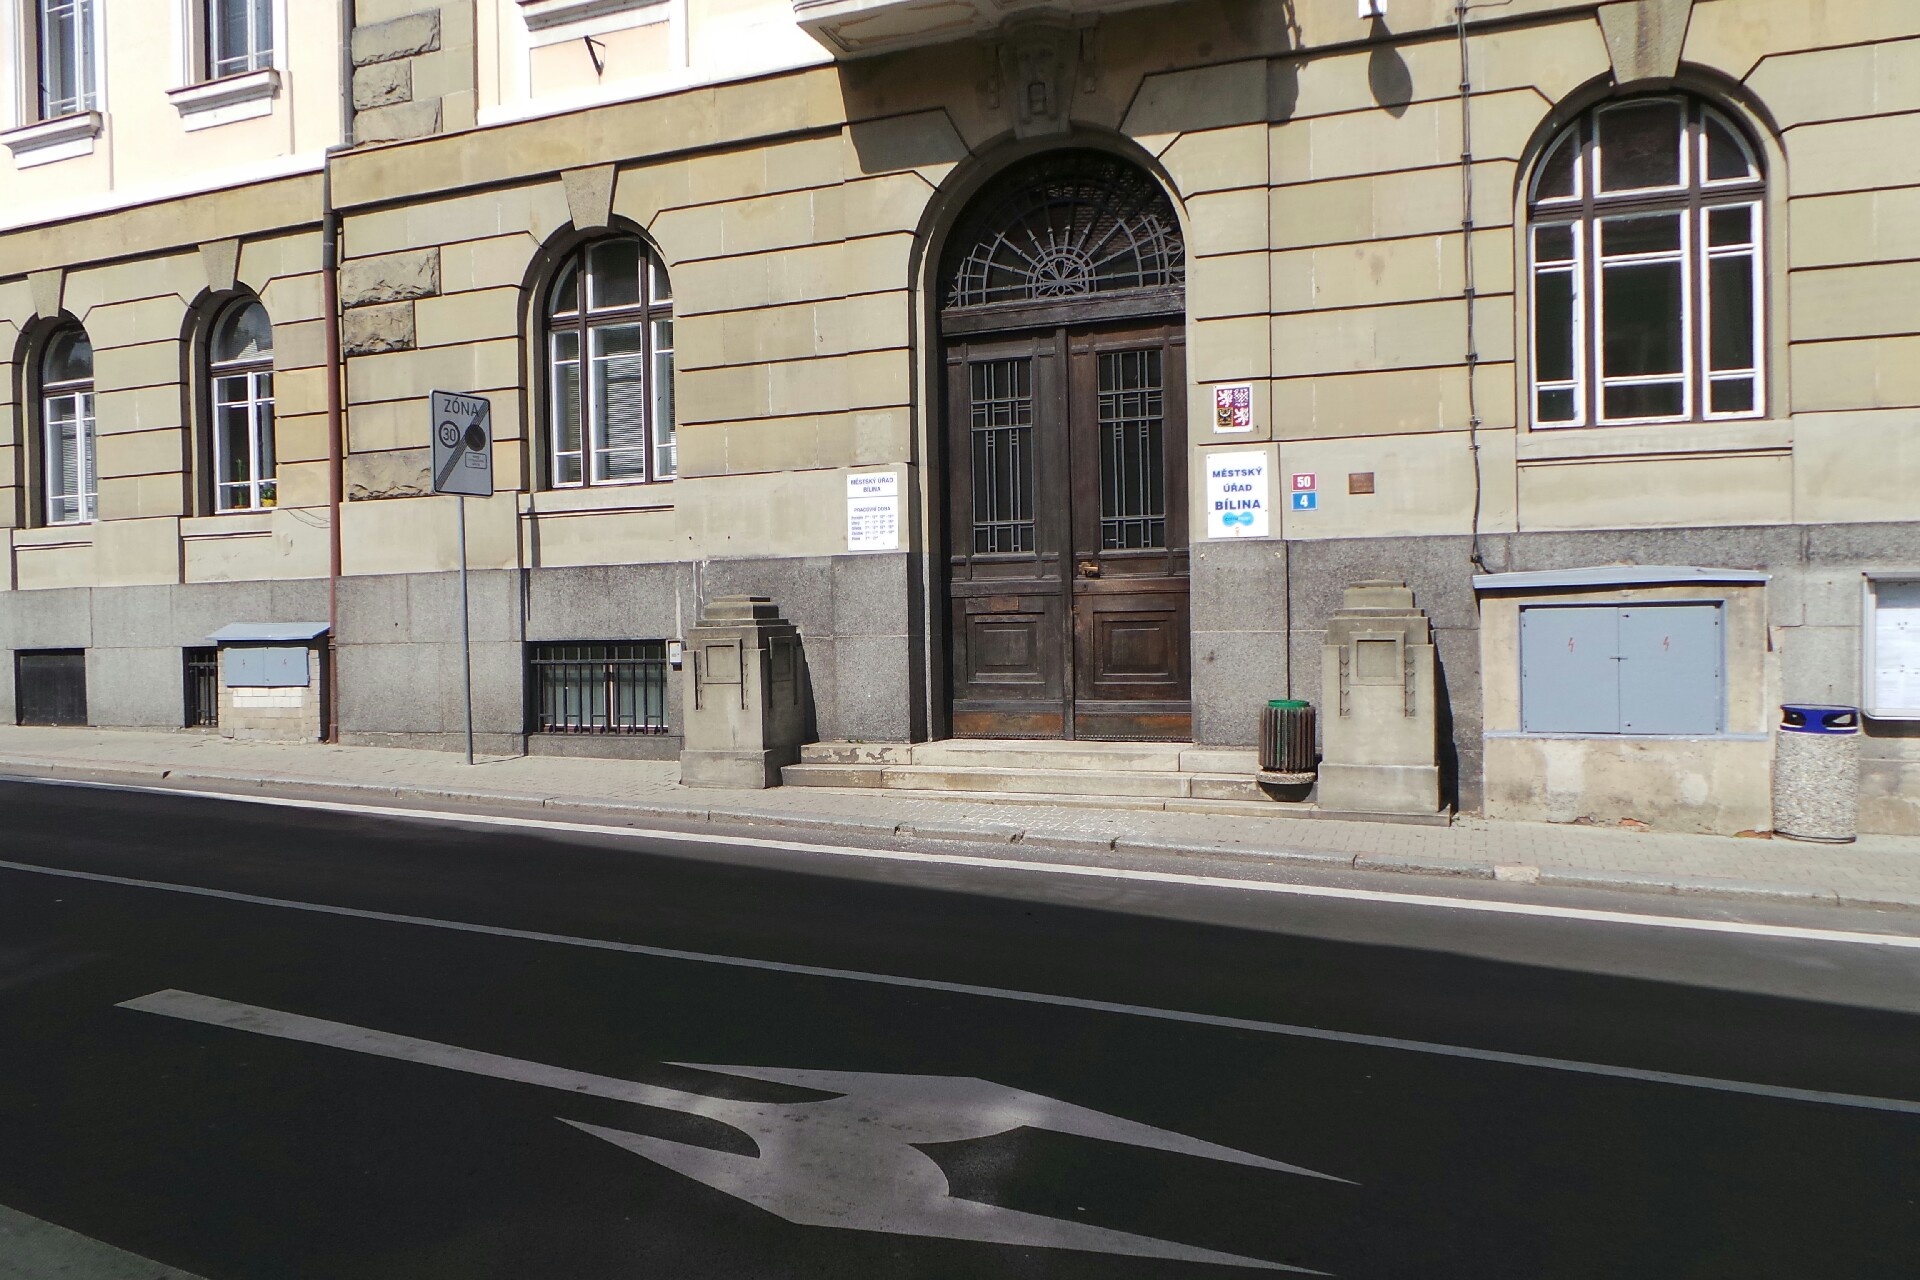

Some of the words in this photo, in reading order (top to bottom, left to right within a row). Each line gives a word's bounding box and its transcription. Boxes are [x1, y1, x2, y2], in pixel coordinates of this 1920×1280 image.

[444, 397, 479, 417] ZÓNA
[443, 428, 456, 442] 30
[1212, 466, 1262, 478] MĚSTSKÝ
[1223, 483, 1252, 492] ÚŘAD
[1297, 476, 1311, 488] 50
[1215, 498, 1261, 511] BÍLINA
[1299, 494, 1309, 507] 4
